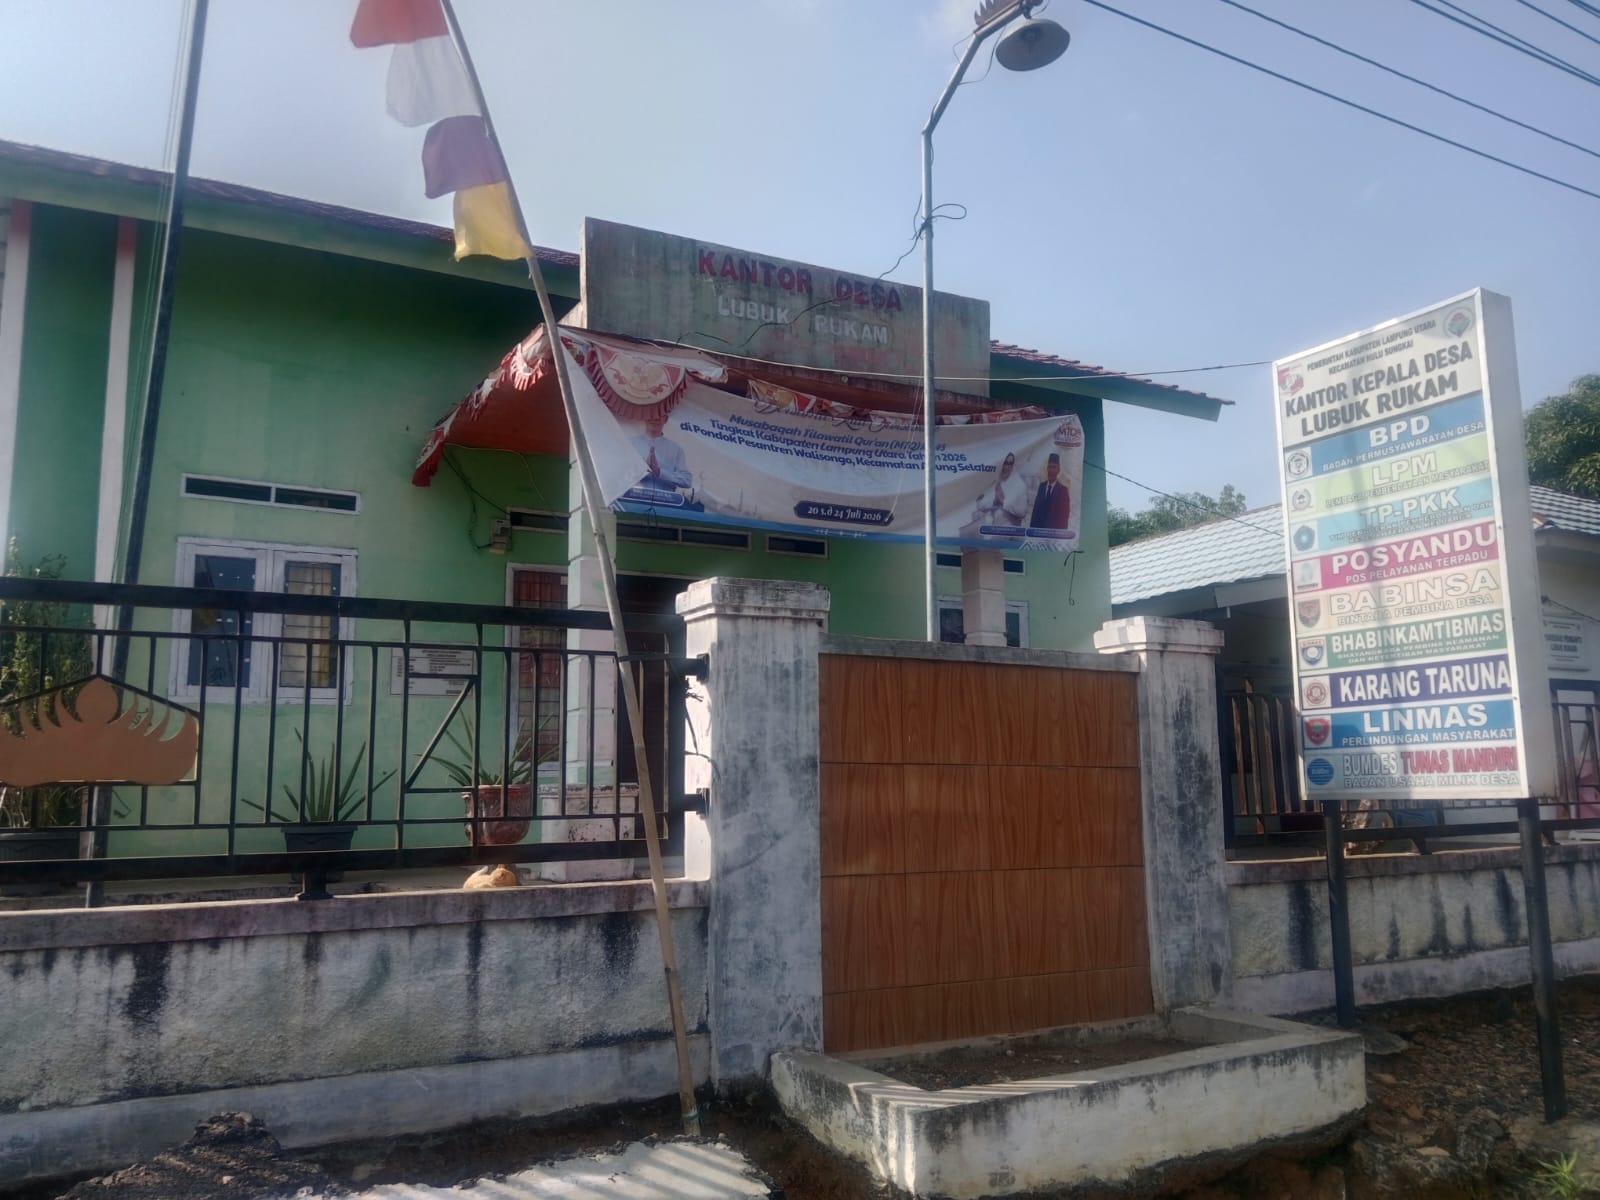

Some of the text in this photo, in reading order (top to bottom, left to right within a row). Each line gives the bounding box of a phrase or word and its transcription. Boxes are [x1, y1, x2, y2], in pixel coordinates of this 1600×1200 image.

[699, 248, 903, 312] KANTOR DESA
[718, 296, 889, 345] LUBUK RUKAM
[1307, 319, 1437, 372] PEMERINTAH KABUPATEN LAMPUNG UTARA
[1328, 356, 1365, 375] KECAMATAN
[1384, 339, 1414, 356] SUNGKAI
[1285, 341, 1473, 419] KANTOR KEPALA DESA
[1301, 371, 1459, 437] LUBUK RUKAM
[680, 421, 693, 433] di
[694, 425, 737, 445] Pondok
[738, 436, 794, 456] Pesantren
[794, 449, 856, 466] Walisongo,
[856, 457, 920, 470] Kecamatan
[958, 463, 997, 473] Selatan
[710, 418, 755, 439] Tingkat
[756, 430, 819, 450] Kabupaten
[820, 442, 876, 459] Lampung
[874, 449, 906, 460] Utara
[907, 451, 941, 461] Tahn
[729, 414, 801, 437] Musabaqah
[803, 428, 854, 444] Tilawatil
[854, 435, 890, 449] Qur'an
[1322, 421, 1484, 472] BADAN PERMUSYAWARATAN DESA
[1369, 414, 1431, 448] BPD
[1372, 450, 1438, 487] LPM
[846, 509, 861, 520] Juli
[1360, 487, 1461, 526] TP-PKK
[1331, 522, 1497, 575] POSYANDU
[1345, 550, 1489, 585] POS PELAYANAN TERPADU
[1329, 568, 1500, 616] BABINSA
[1337, 594, 1496, 626] BINTARA PEMBINA DESA
[1332, 612, 1505, 654] BHABINKAMTIBMAS
[1339, 660, 1512, 703] KARANG TARUNA
[1342, 727, 1515, 747] PERLINDUNGAN MASYARAKAT
[1363, 703, 1489, 733] LINMAS
[1343, 746, 1519, 776] BUMDES TUNAS MANDIRI
[1344, 772, 1520, 788] BADAN USAHA MILIK DESA
